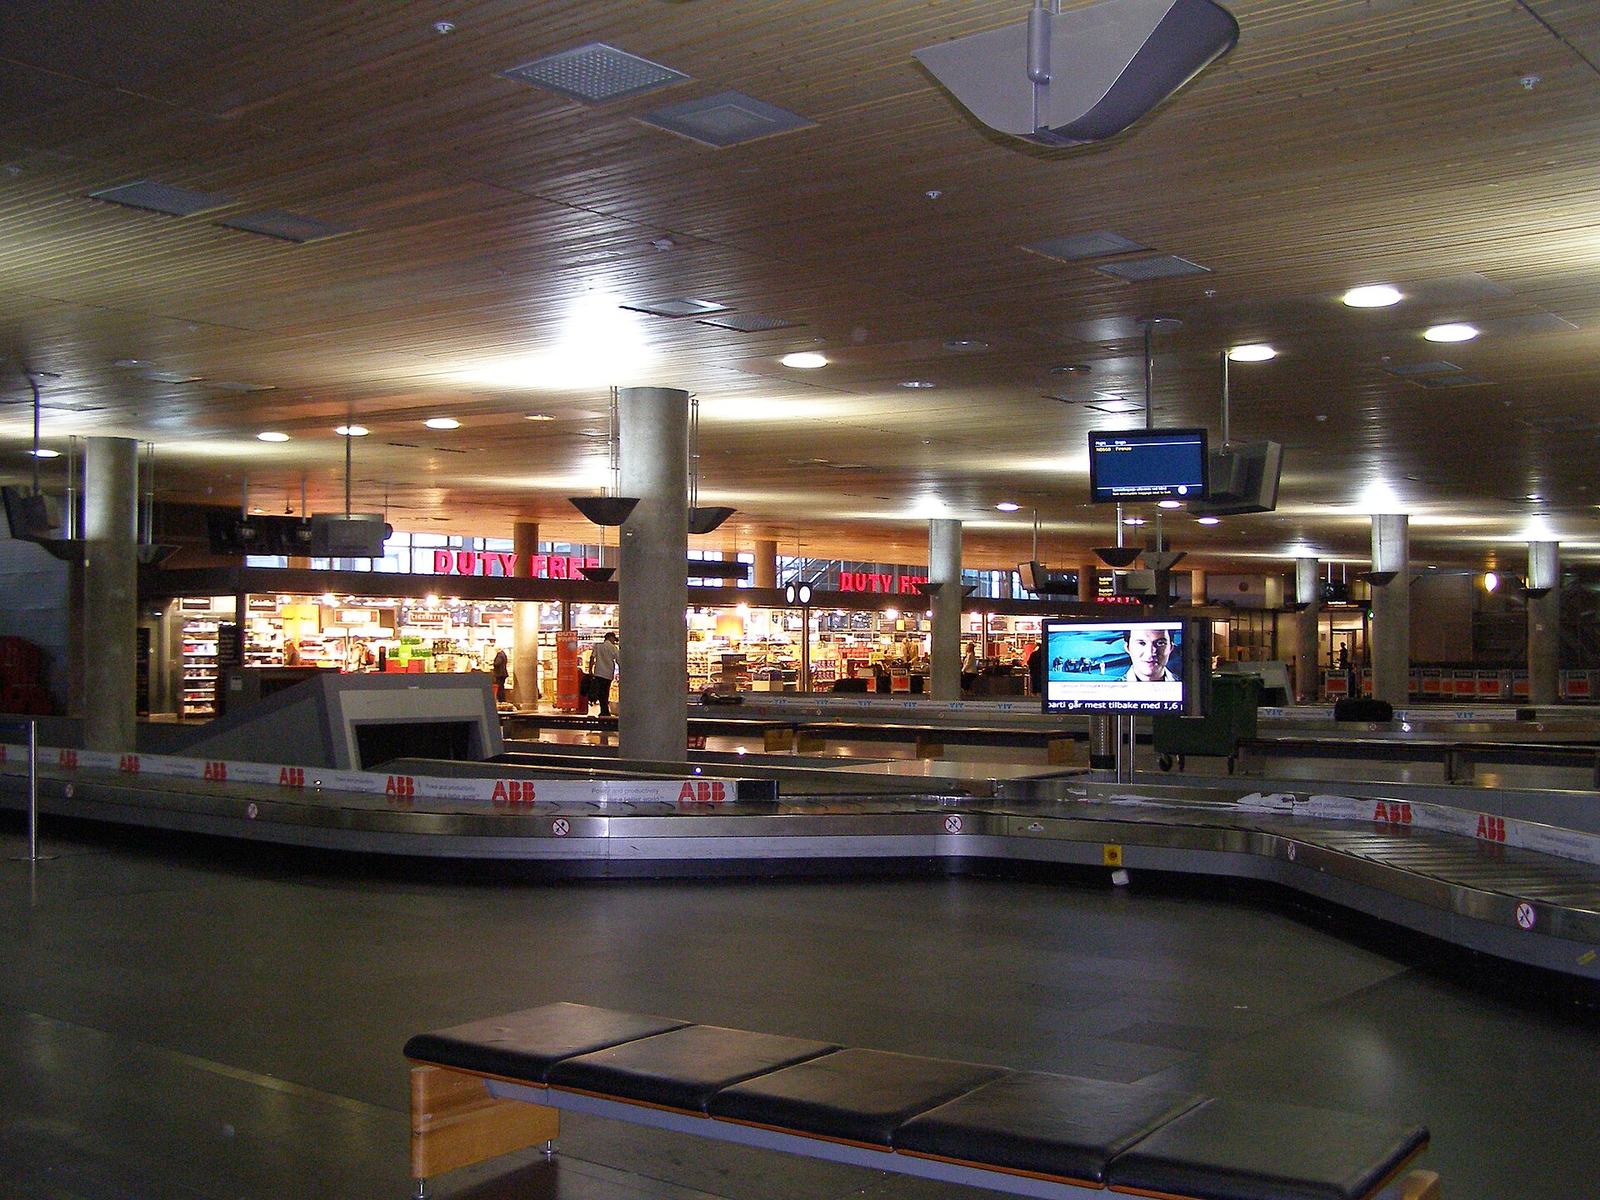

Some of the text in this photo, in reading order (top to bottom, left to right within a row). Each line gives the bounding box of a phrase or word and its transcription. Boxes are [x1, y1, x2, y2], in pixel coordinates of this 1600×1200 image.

[434, 550, 518, 577] DUTY
[838, 572, 893, 593] DUTY
[1068, 699, 1082, 710] går
[1108, 701, 1139, 709] tilbake
[1140, 701, 1160, 709] med
[1163, 701, 1178, 711] 1,6
[60, 749, 78, 769] ABB
[120, 754, 140, 773] ABB
[204, 761, 227, 781] ABB
[280, 767, 305, 787] ABB
[386, 775, 415, 795] ABB
[492, 780, 536, 801] ABB
[678, 781, 725, 802] ABB
[1373, 801, 1412, 824] ABB
[1476, 815, 1506, 843] ABB
